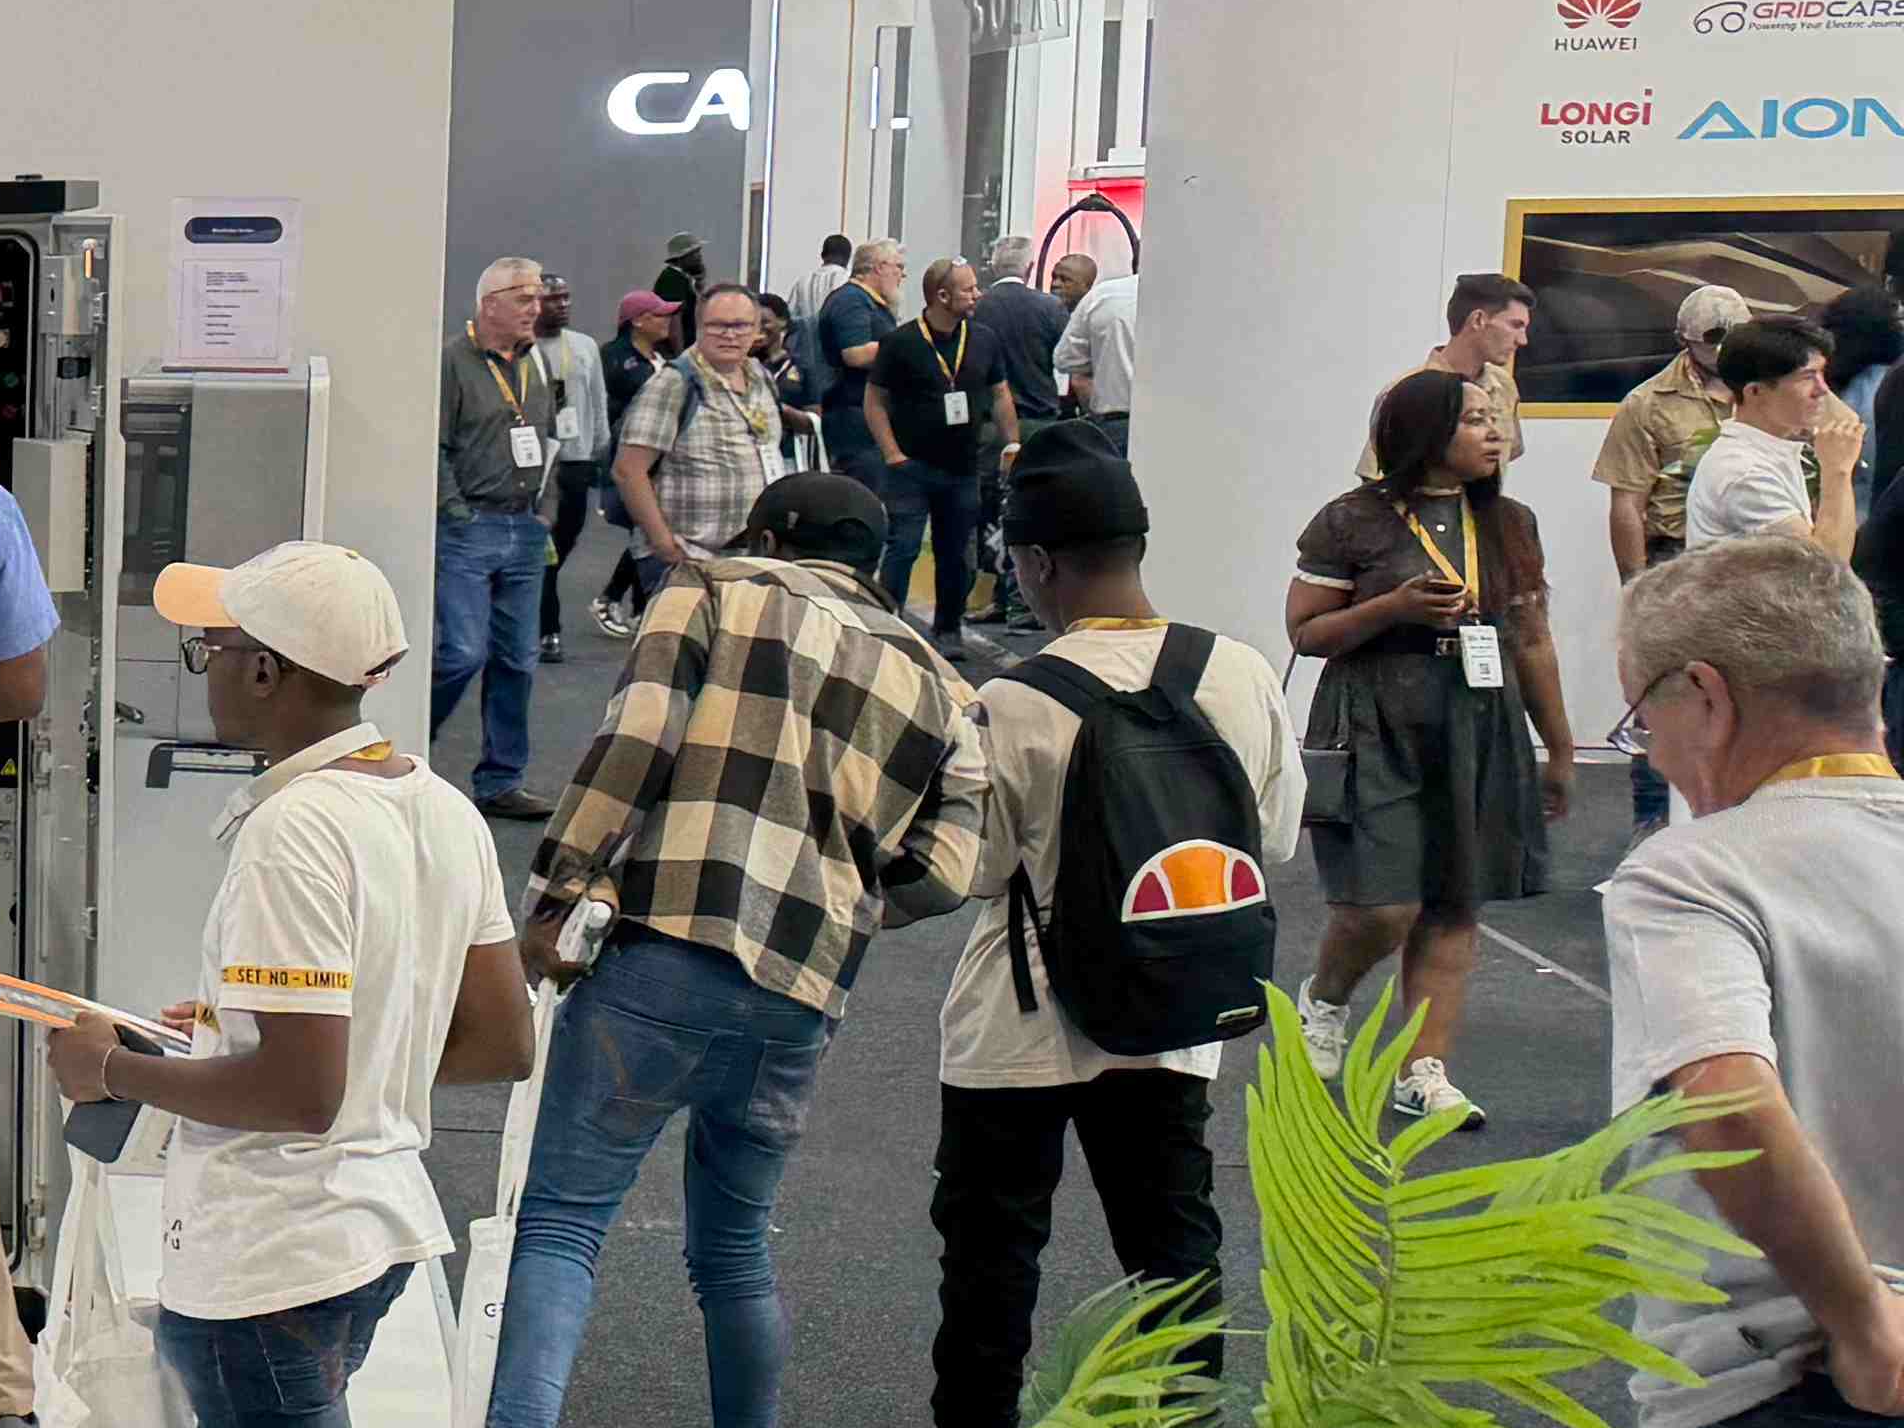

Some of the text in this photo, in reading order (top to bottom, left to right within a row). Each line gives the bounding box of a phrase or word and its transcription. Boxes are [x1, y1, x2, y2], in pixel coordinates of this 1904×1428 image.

[1867, 20, 1904, 30] Journe
[1554, 38, 1638, 51] HUAWEI
[1677, 98, 1904, 140] AION
[1561, 130, 1631, 145] SOLAR
[237, 968, 262, 984] SET
[269, 970, 288, 986] NO
